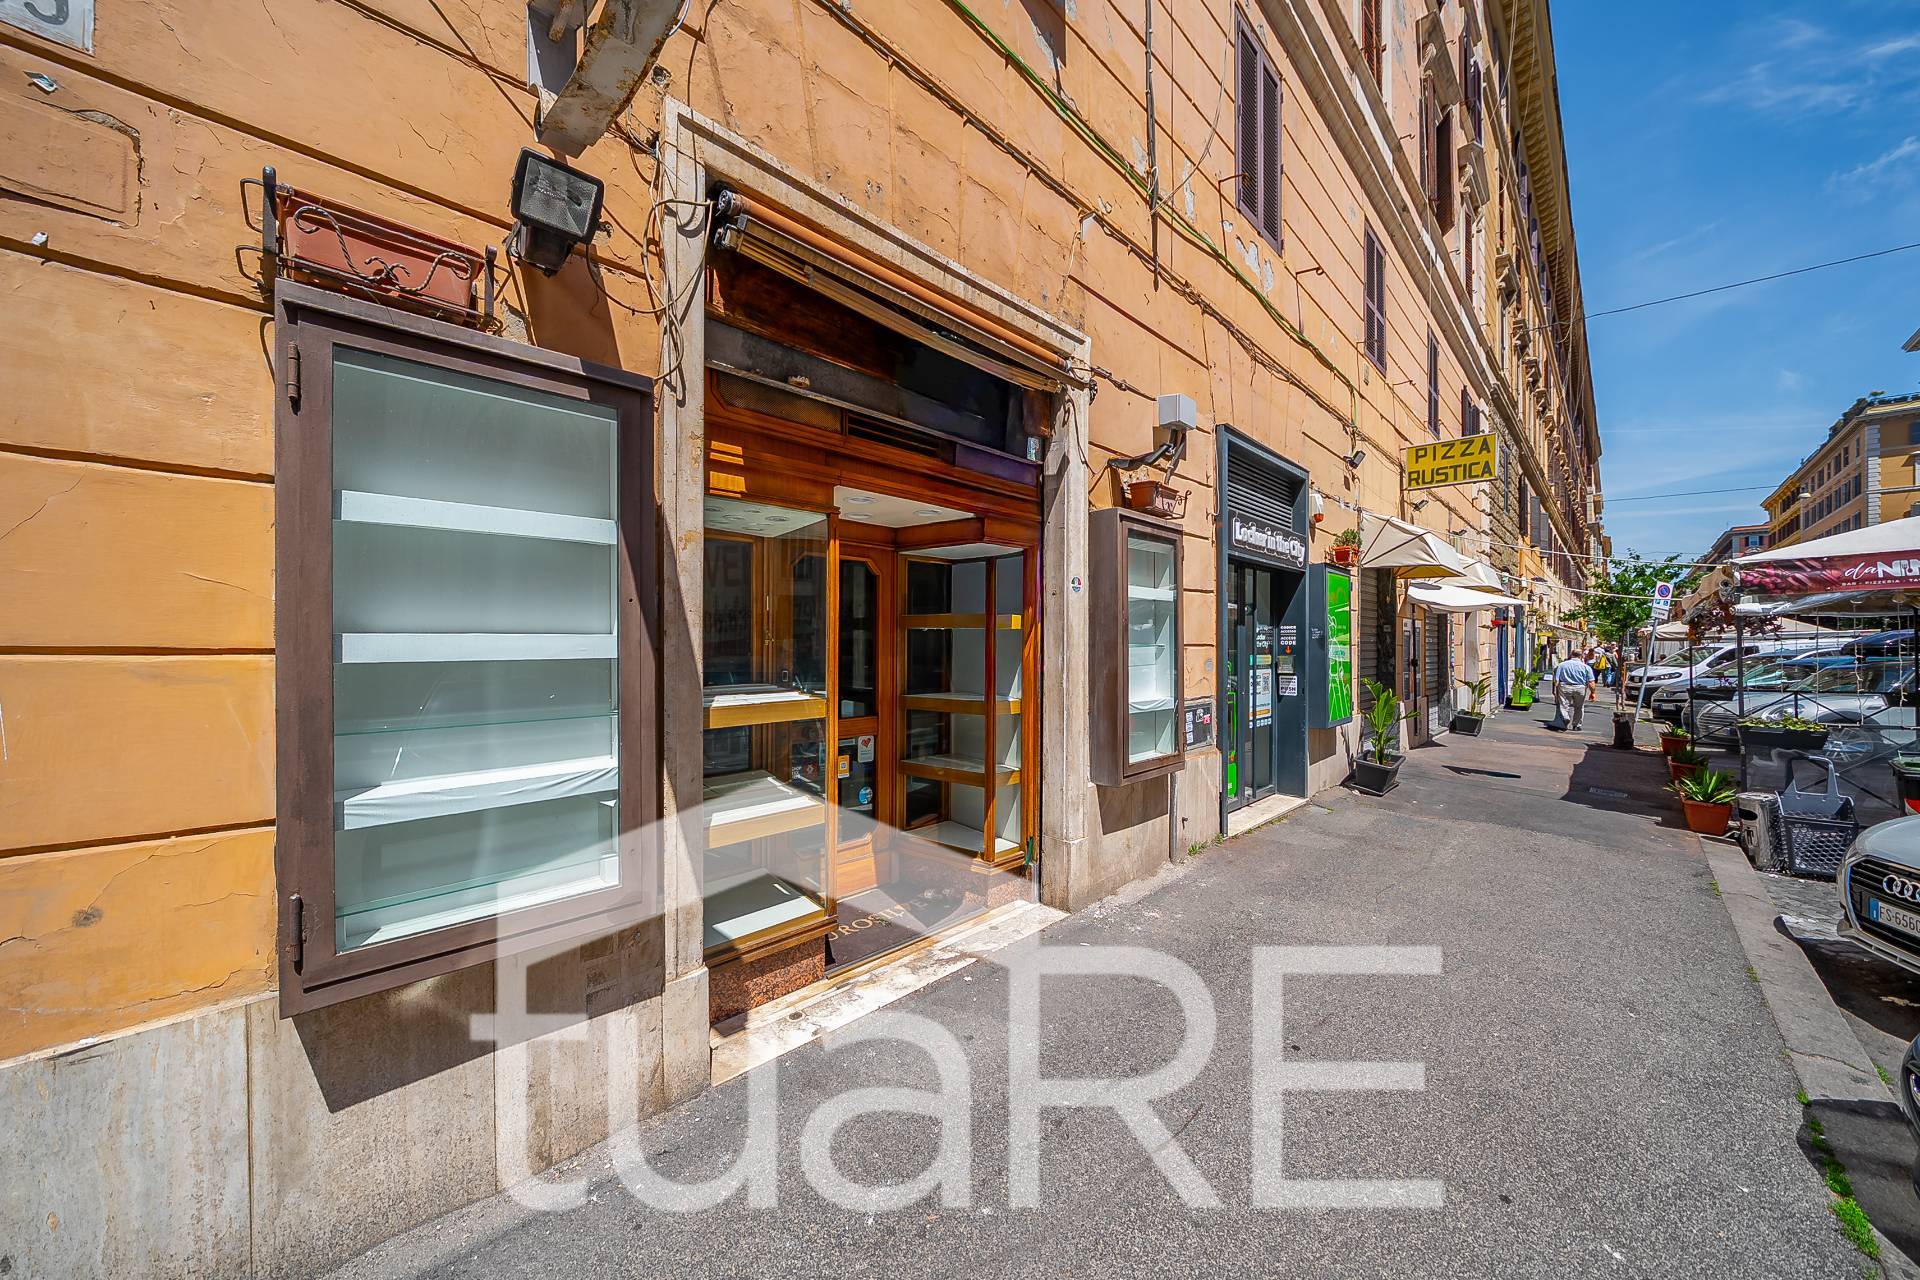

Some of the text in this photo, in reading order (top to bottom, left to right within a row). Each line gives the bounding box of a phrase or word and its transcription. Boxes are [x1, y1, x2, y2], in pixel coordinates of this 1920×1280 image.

[1415, 437, 1491, 464] PIZZA
[1408, 460, 1493, 487] RUSTICA
[1235, 521, 1268, 547] Locker
[1267, 530, 1277, 550] in
